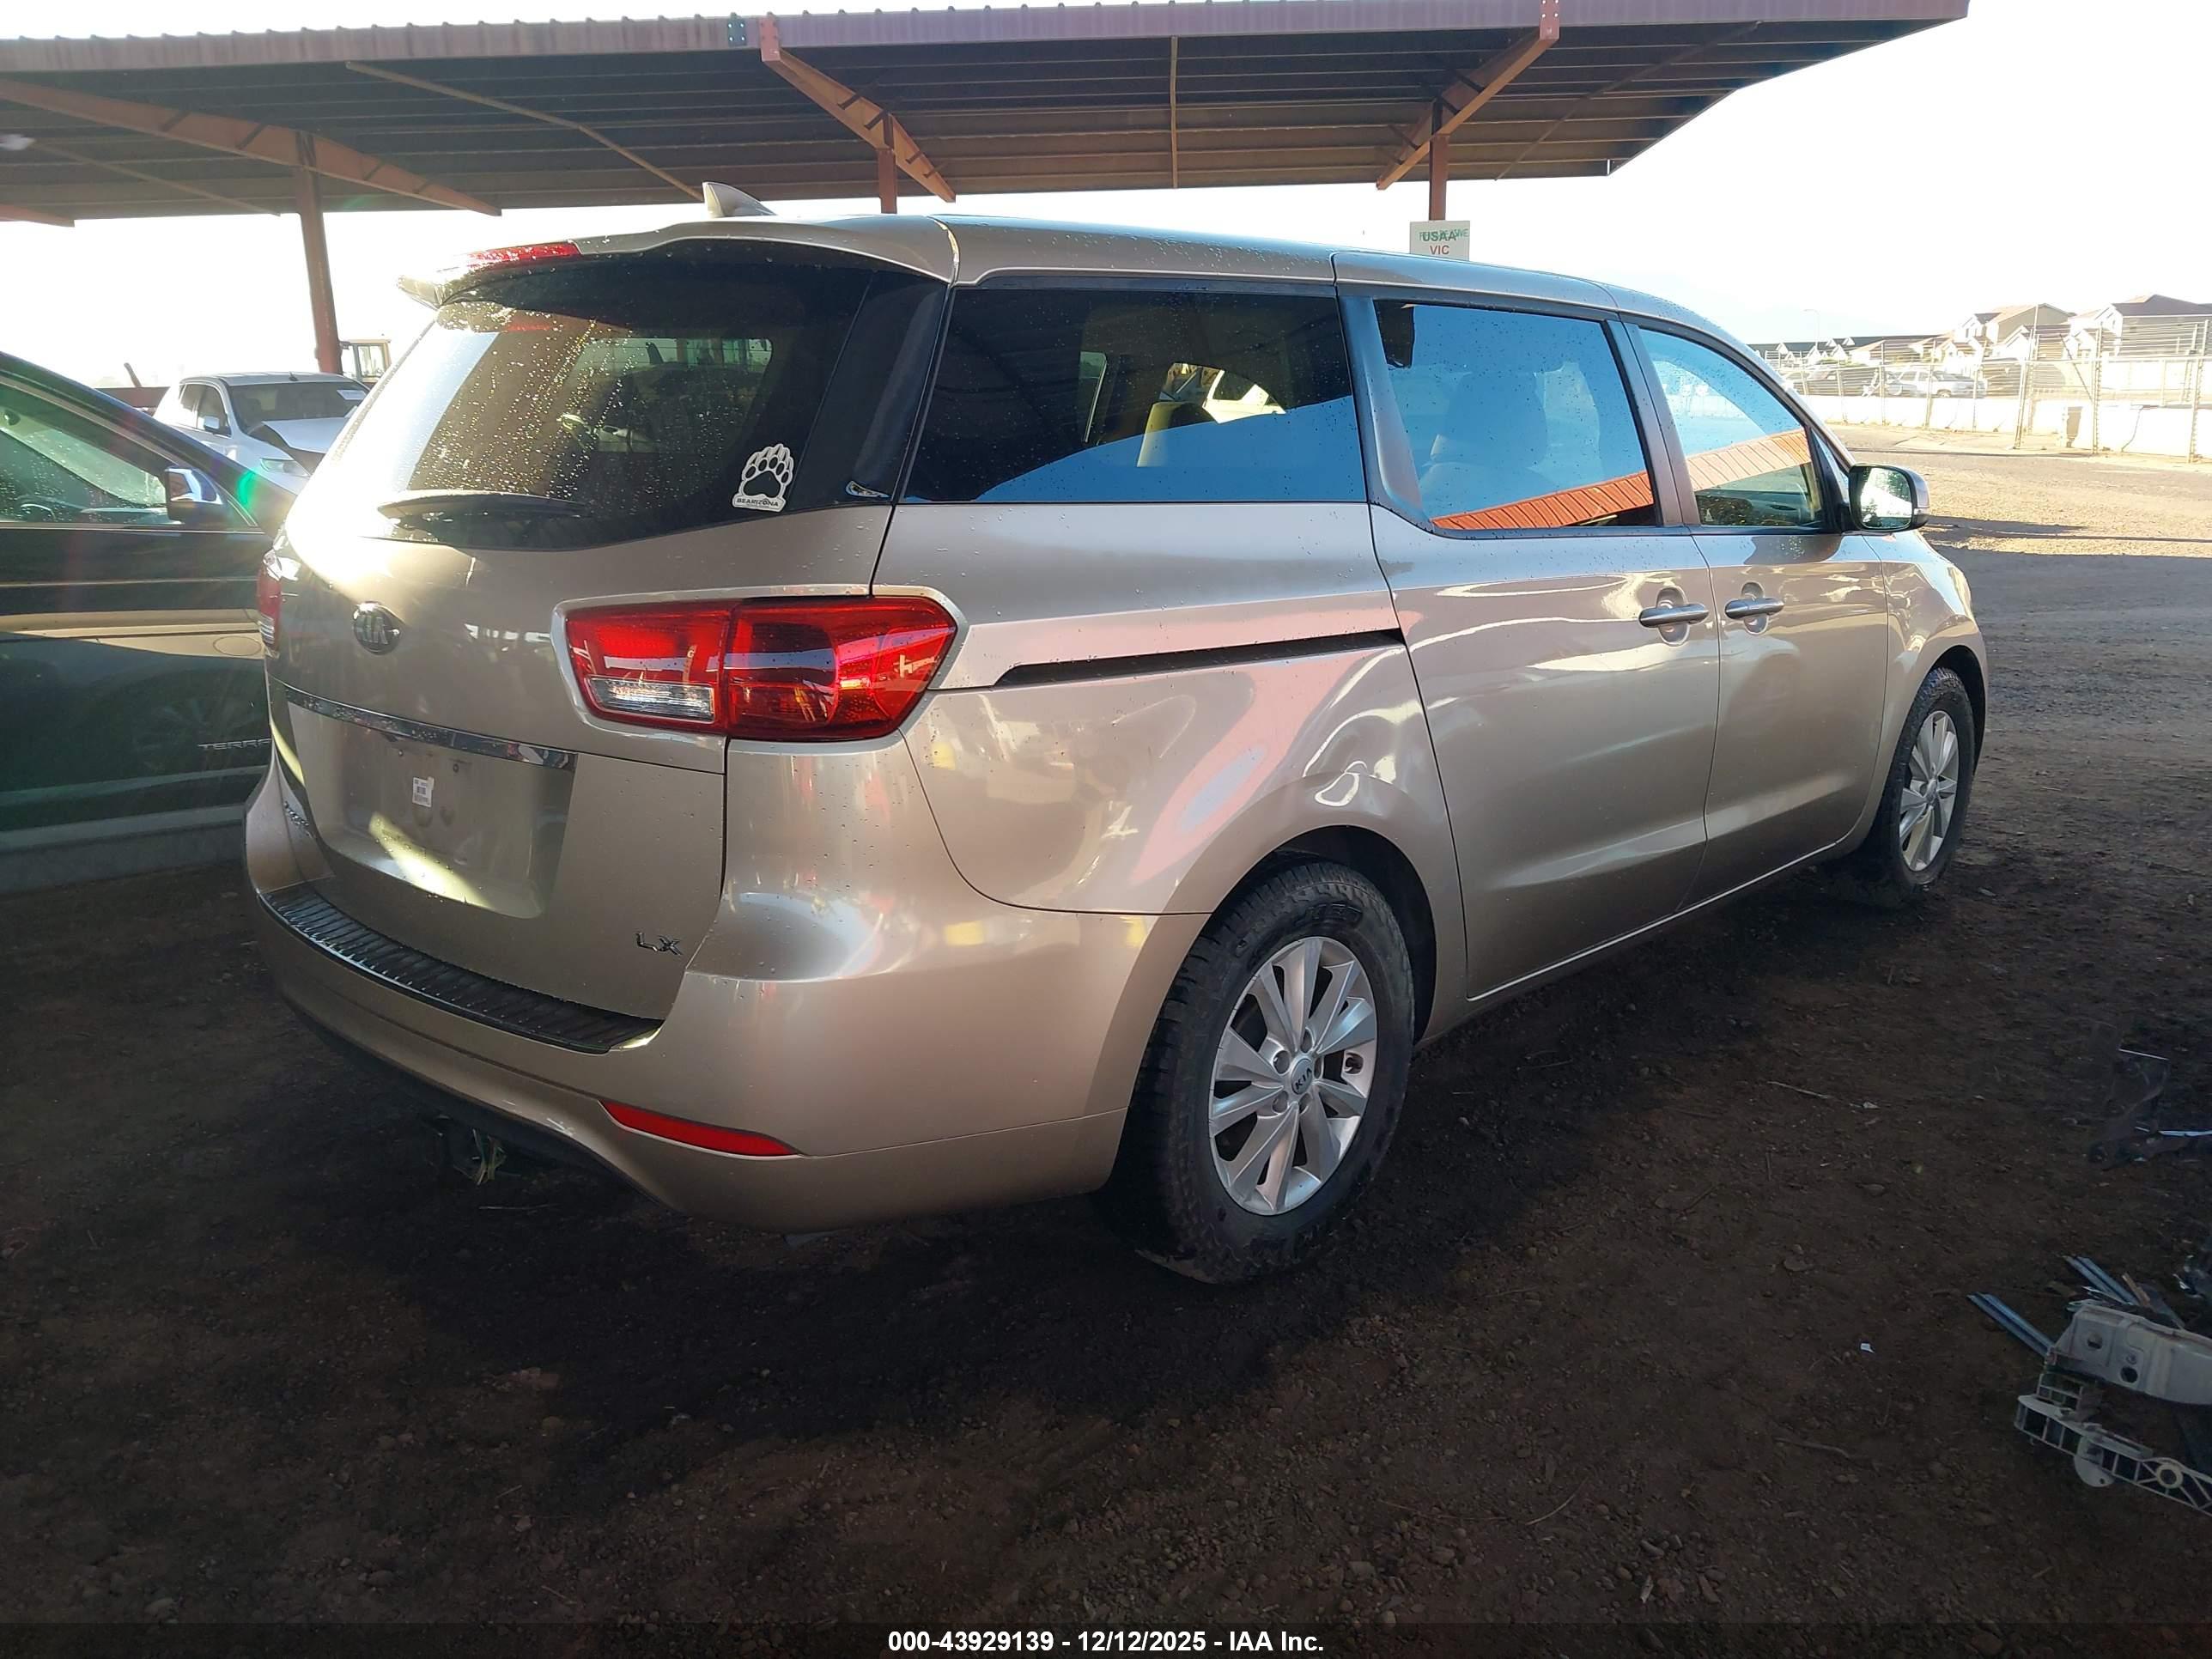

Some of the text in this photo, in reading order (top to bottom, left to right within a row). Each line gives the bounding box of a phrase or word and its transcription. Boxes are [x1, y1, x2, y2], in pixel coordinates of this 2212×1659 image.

[1422, 231, 1456, 241] USAA
[1429, 245, 1450, 255] VIC
[635, 933, 684, 956] LX
[1295, 1067, 1312, 1091] KIA
